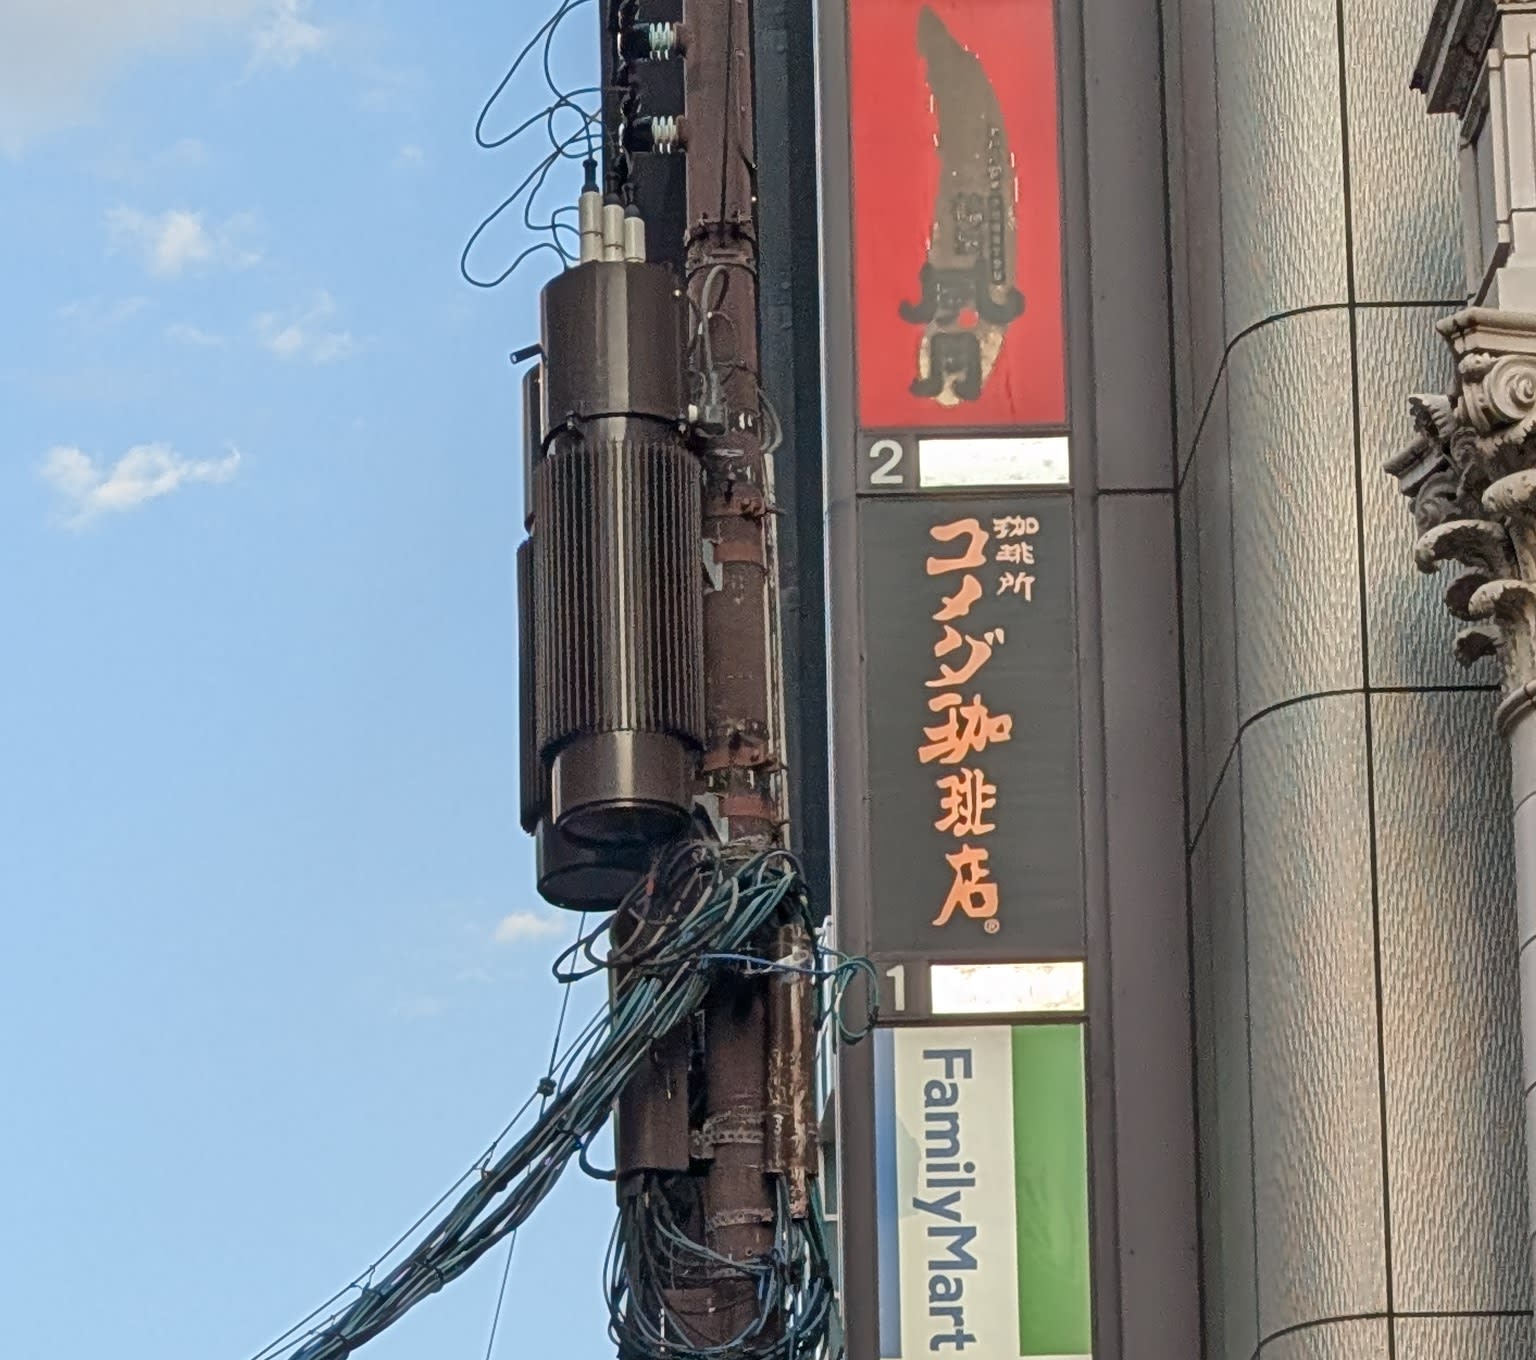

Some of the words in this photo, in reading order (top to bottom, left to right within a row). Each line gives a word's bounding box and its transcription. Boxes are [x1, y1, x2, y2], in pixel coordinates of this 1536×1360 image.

[869, 441, 904, 485] 2
[993, 516, 1040, 602] 珈琲所
[919, 517, 1013, 929] コメダ珈琲店
[886, 965, 906, 1011] 1
[912, 1048, 977, 1352] FamilyMart
